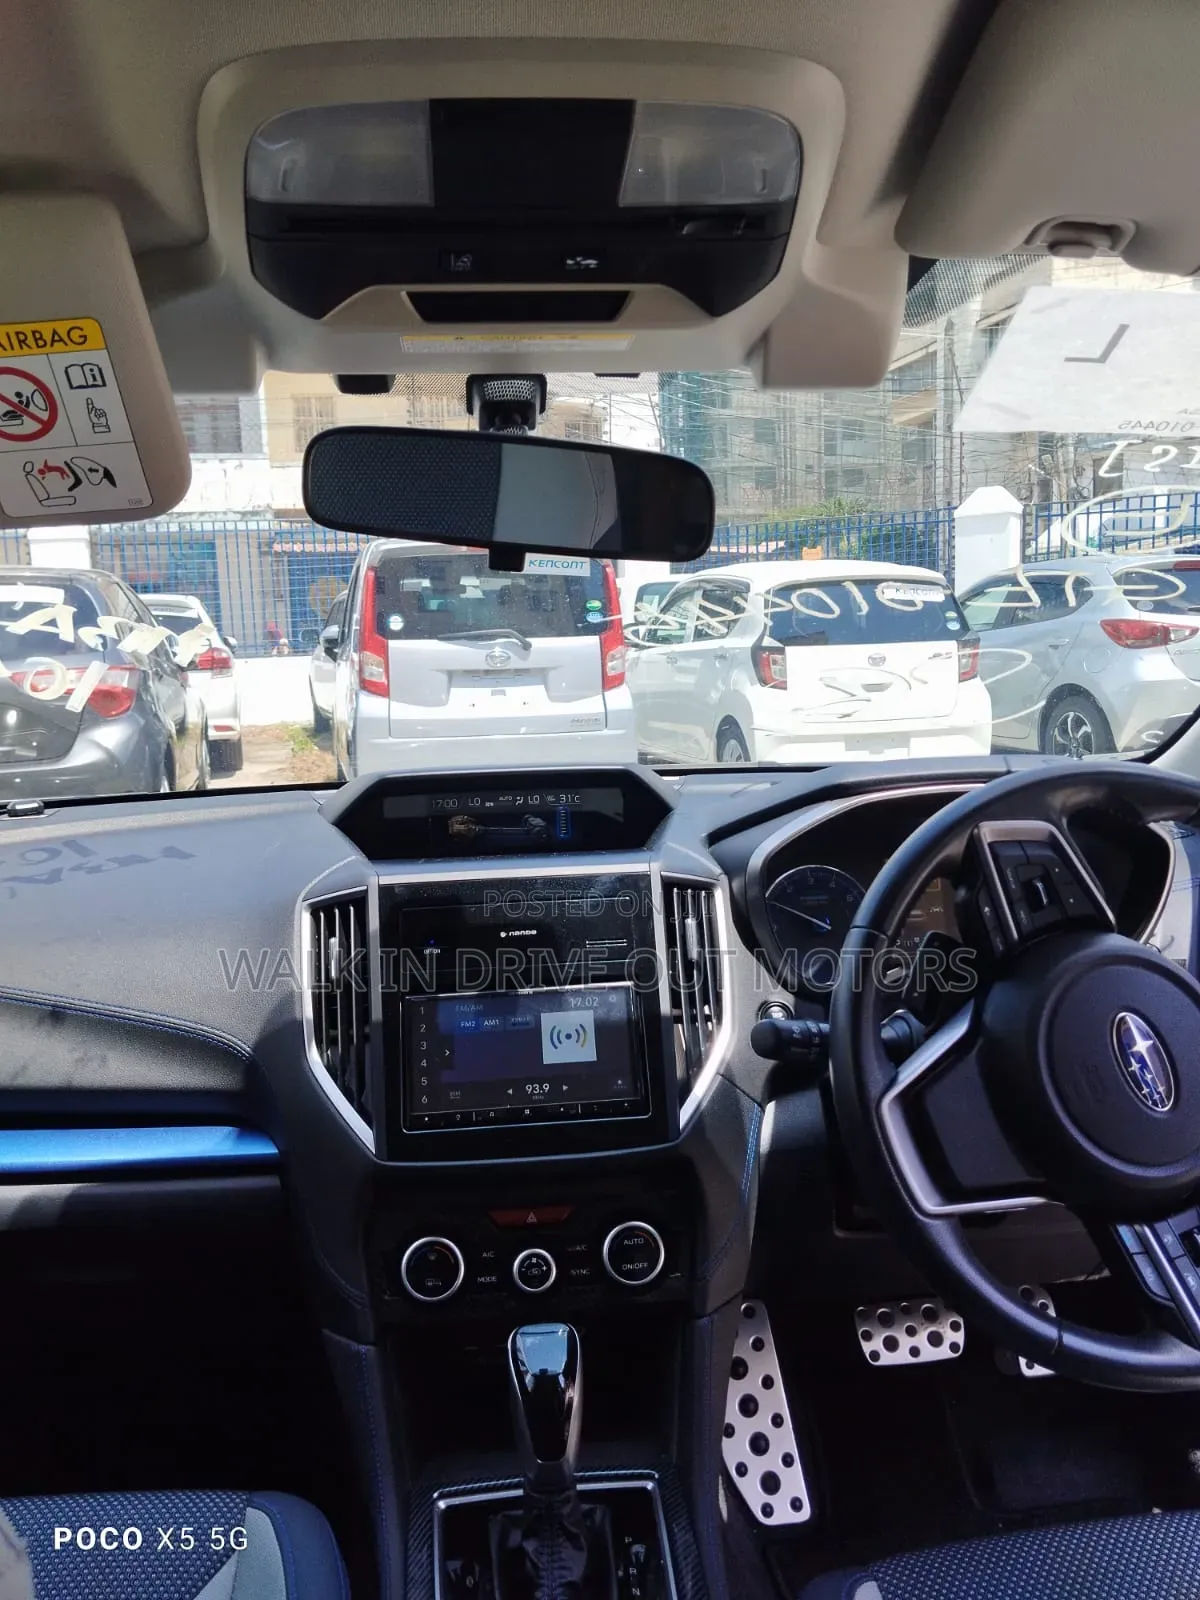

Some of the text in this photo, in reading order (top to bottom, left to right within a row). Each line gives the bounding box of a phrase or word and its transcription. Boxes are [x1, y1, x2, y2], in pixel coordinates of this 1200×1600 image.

[420, 1024, 427, 1033] 2
[420, 1041, 427, 1050] 3
[421, 1059, 427, 1067] 4
[421, 1077, 428, 1086] 5
[525, 1083, 550, 1094] 93.9
[623, 1237, 644, 1245] AUTO
